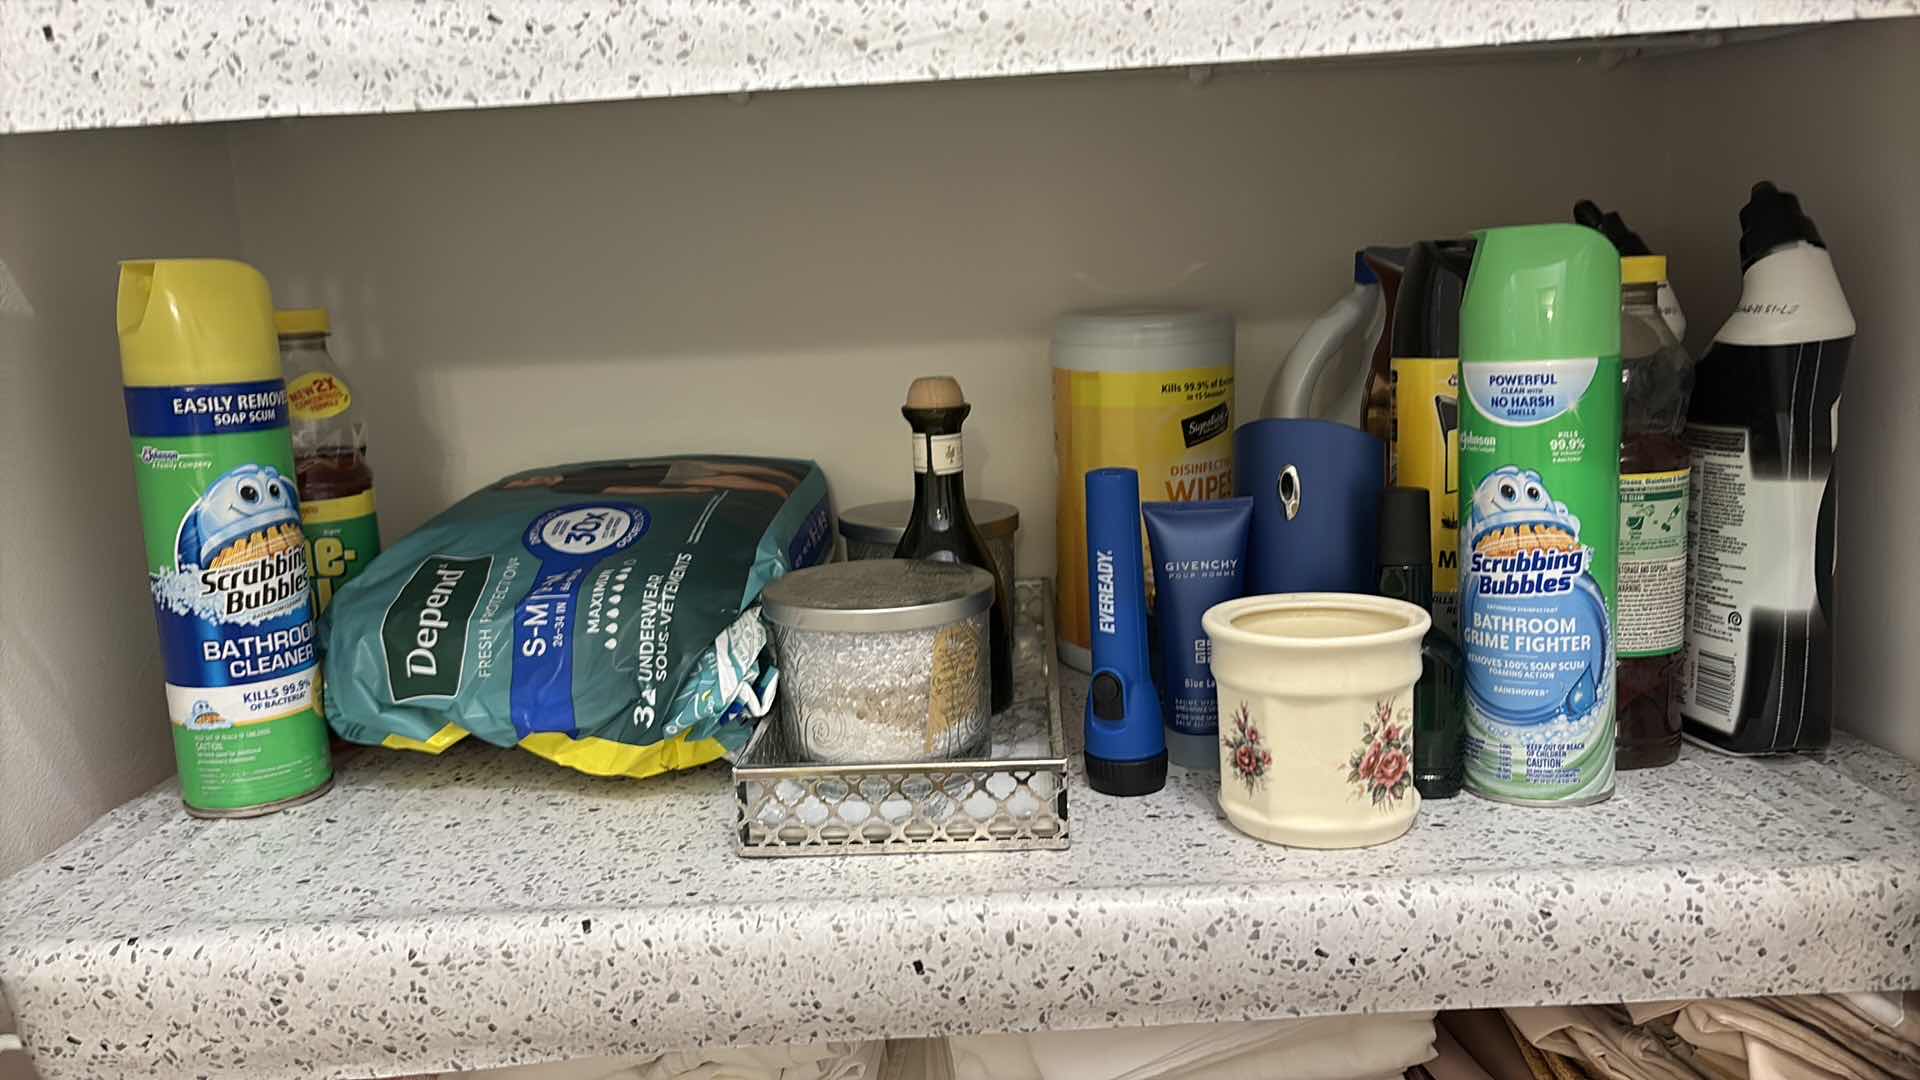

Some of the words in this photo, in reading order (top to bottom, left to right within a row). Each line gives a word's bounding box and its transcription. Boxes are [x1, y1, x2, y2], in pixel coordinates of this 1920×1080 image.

[1161, 383, 1181, 393] Kills
[1184, 380, 1209, 392] 99.9%
[1488, 373, 1557, 386] POWERFUL
[1500, 386, 1526, 395] CLEAN
[172, 396, 233, 416] EASILY
[1490, 396, 1509, 408] NO
[1511, 395, 1555, 408] HARSH
[1506, 408, 1537, 416] SMELLS
[213, 413, 247, 427] SOAP
[248, 409, 276, 423] SCUM
[1549, 437, 1585, 451] 99.9%
[563, 511, 611, 546] 30X
[1165, 559, 1238, 572] GIVENCHY
[1471, 549, 1583, 575] Scrubbing
[1168, 571, 1196, 579] POUR
[1201, 570, 1236, 578] HOMME
[1479, 573, 1572, 595] Bubbles
[226, 572, 308, 615] Bubbles
[406, 568, 465, 678] Depend
[655, 552, 693, 682] SOUS-VÊTEMENTS
[1473, 612, 1576, 635] BATHROOM
[522, 602, 550, 657] S-M
[552, 615, 566, 648] 26-34
[637, 574, 665, 683] UNDERWEAR
[1463, 627, 1510, 651] GRIME
[1514, 634, 1592, 652] FIGHTER
[203, 621, 314, 661] BATHROO
[229, 643, 314, 679] CLEANER
[478, 628, 493, 679] FRESH
[1503, 660, 1529, 671] 100%
[1529, 660, 1558, 671] SOAP
[1558, 660, 1585, 671] SCUM
[1522, 670, 1555, 680] ACTION
[242, 687, 280, 704] KILLS
[282, 679, 311, 696] 99.9%
[1184, 678, 1204, 689] Blue
[250, 701, 262, 711] OF
